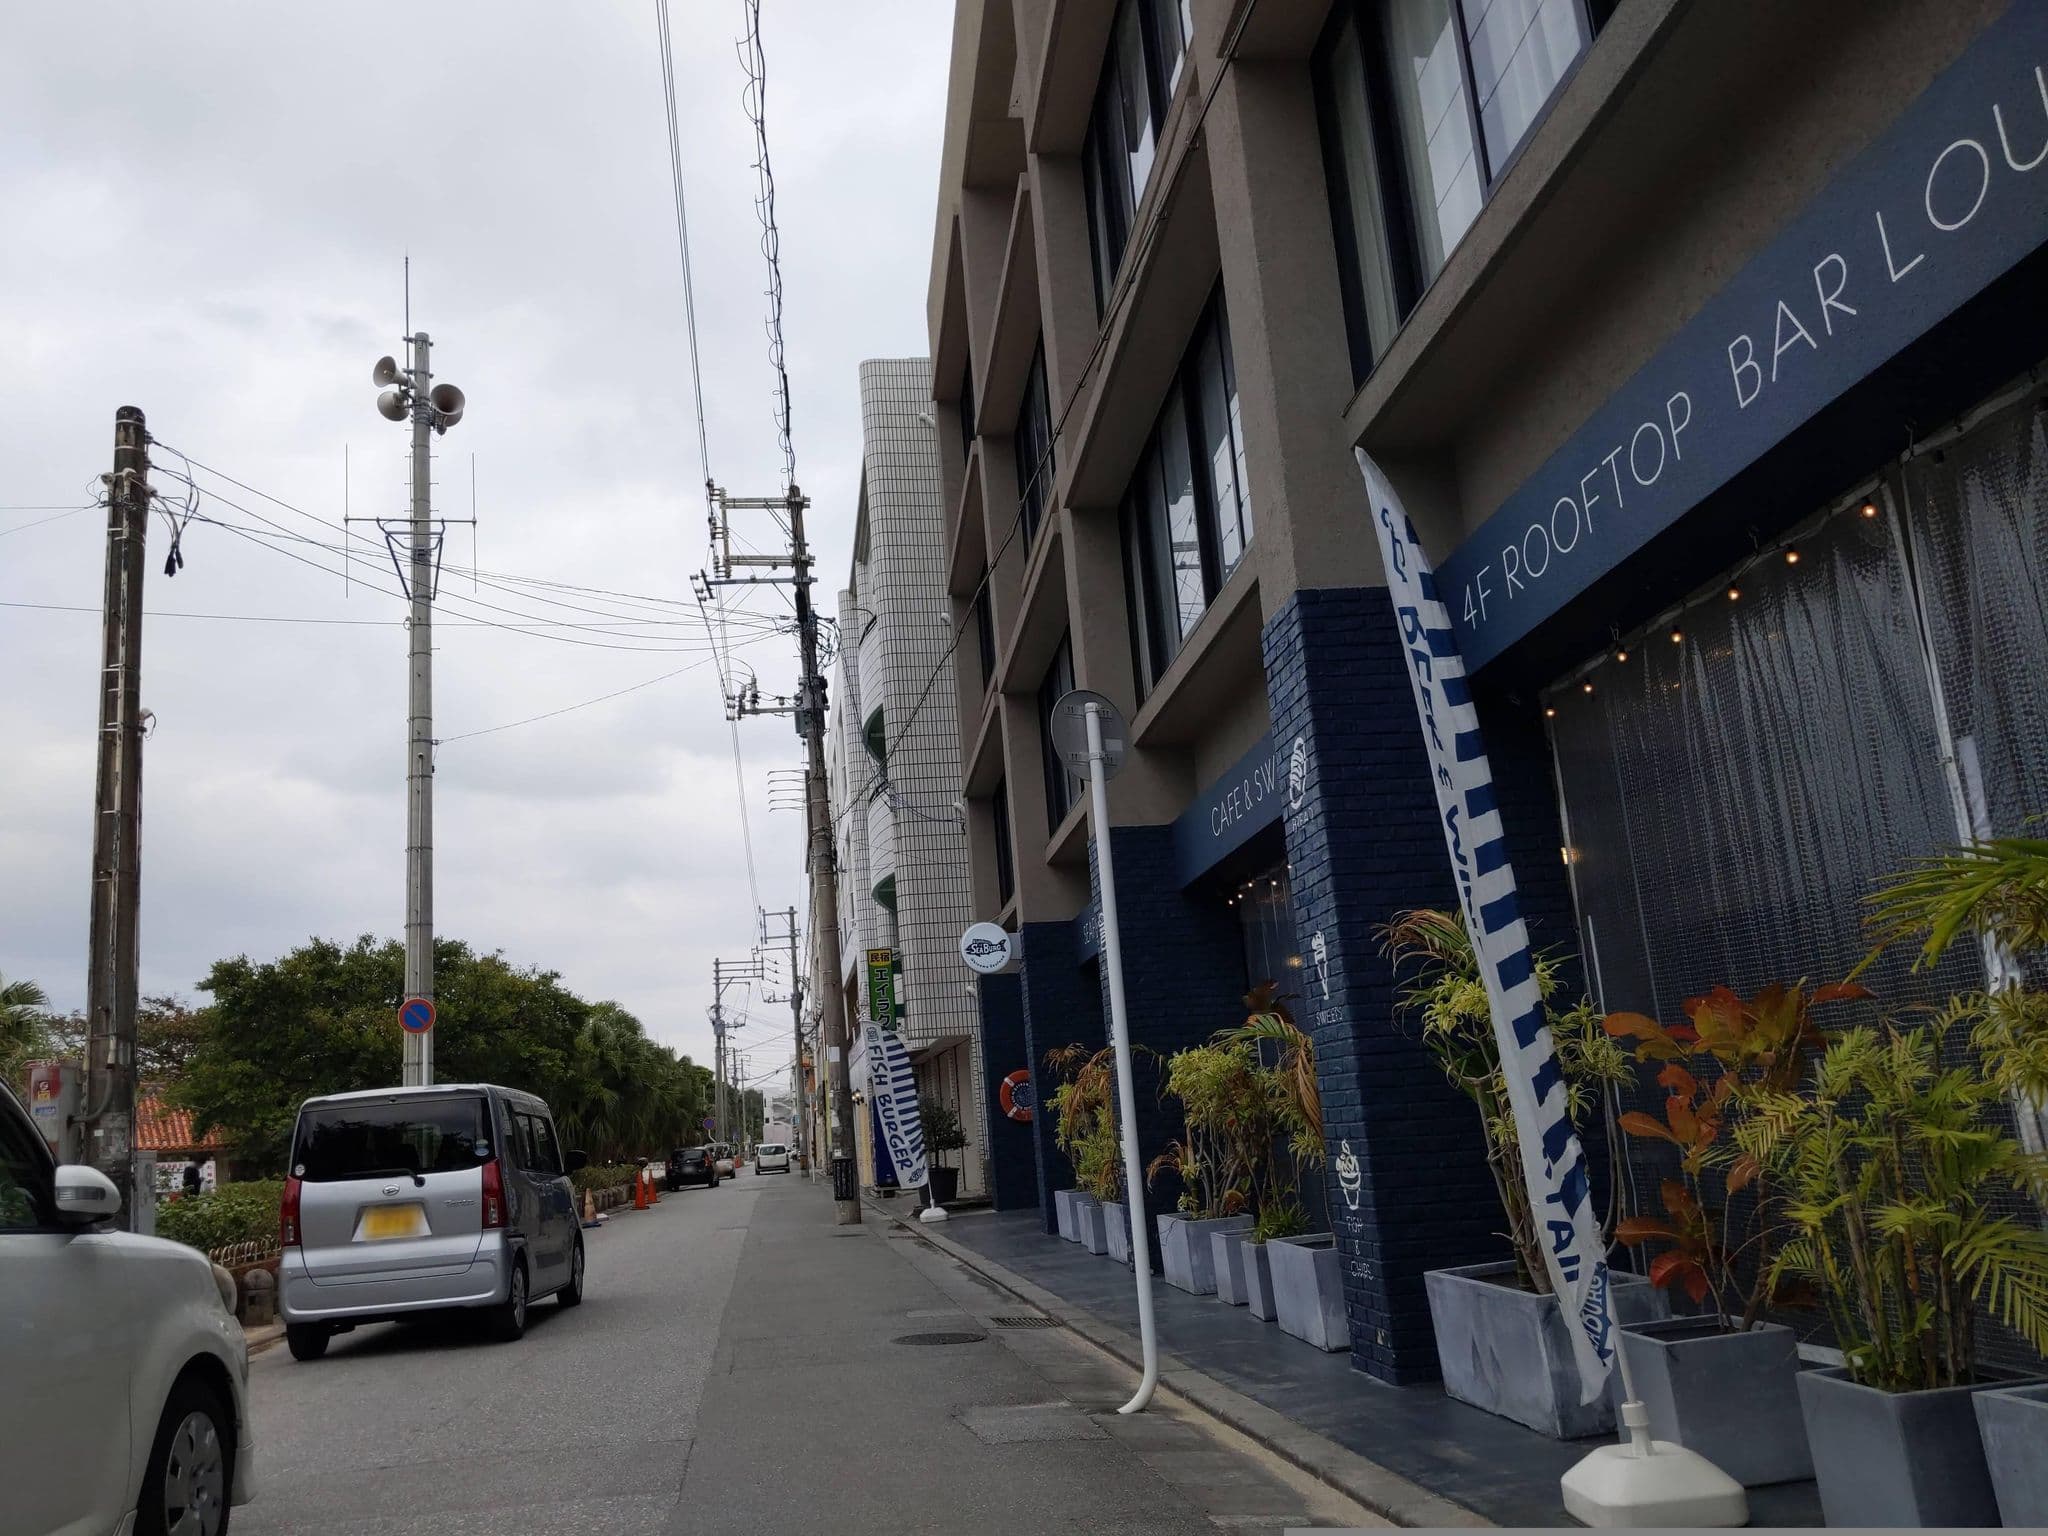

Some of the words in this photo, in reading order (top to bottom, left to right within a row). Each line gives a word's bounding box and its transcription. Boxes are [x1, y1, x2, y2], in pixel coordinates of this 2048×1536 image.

[1463, 566, 1492, 632] 4F
[1501, 391, 1692, 600] ROOFTOP
[1727, 253, 1857, 409] BAR
[1875, 66, 2048, 283] LOU
[1211, 786, 1243, 836] CAFE
[1243, 779, 1254, 811] &
[870, 952, 890, 963] 民宿
[875, 968, 892, 1029] エイラク
[868, 1045, 889, 1087] FISH
[877, 1092, 914, 1171] BURGER
